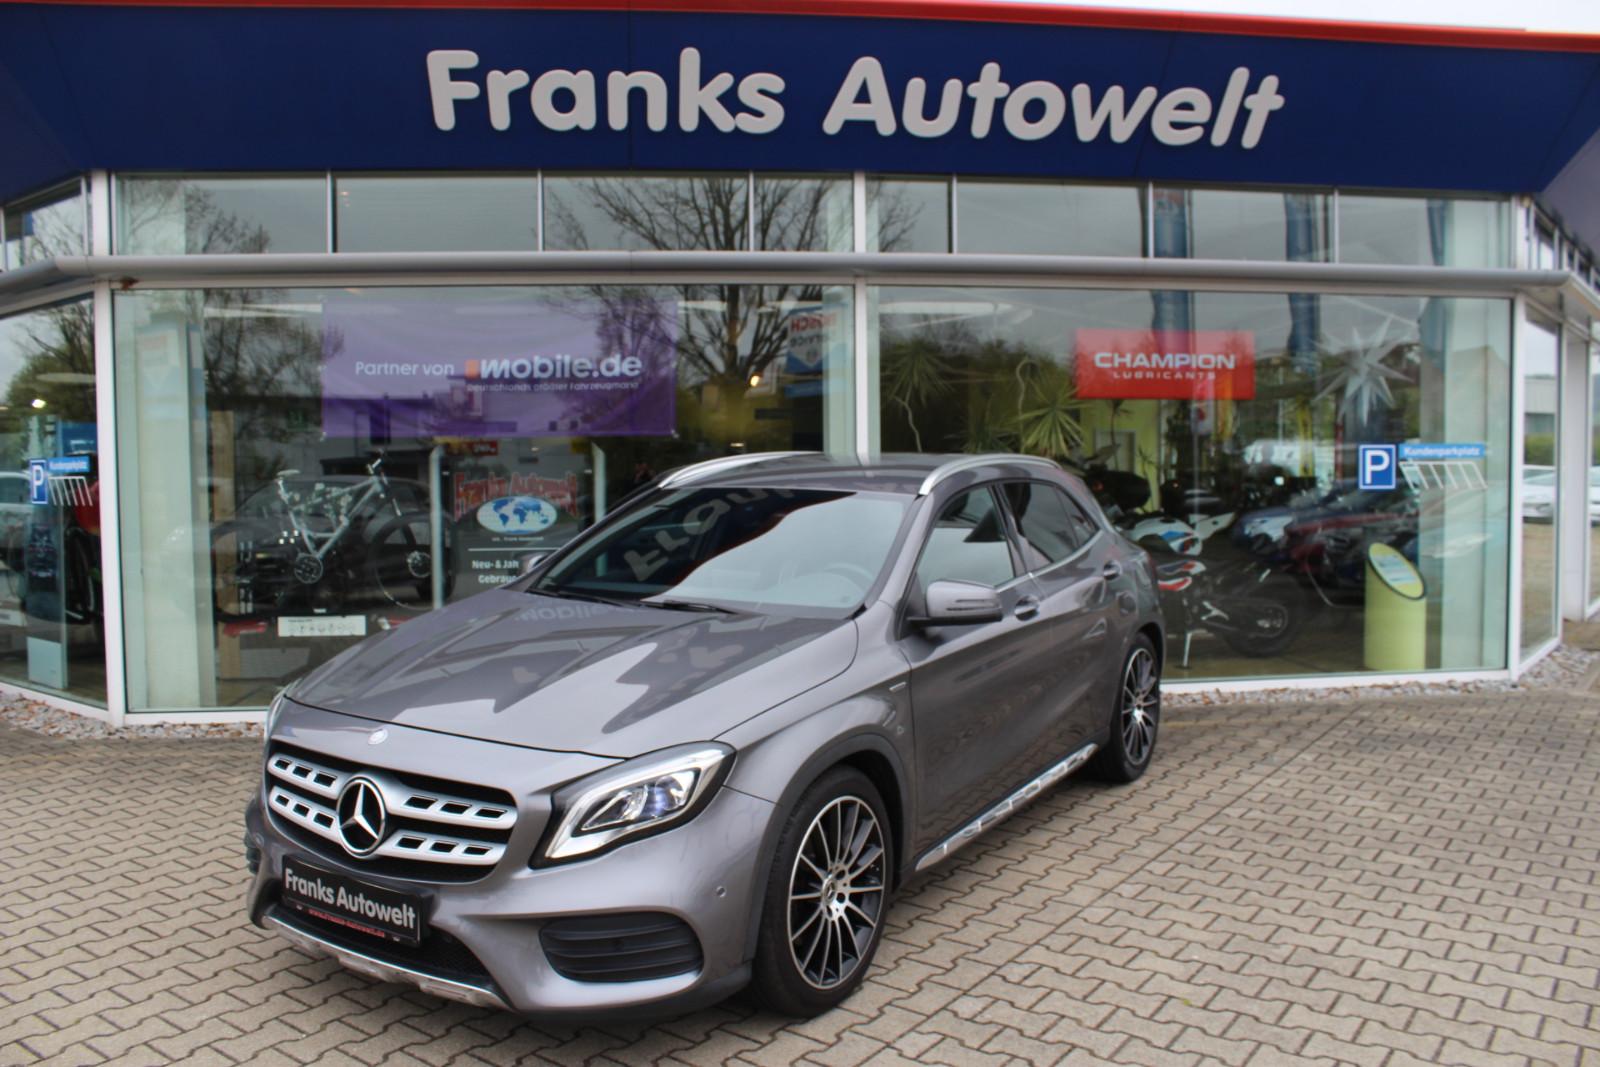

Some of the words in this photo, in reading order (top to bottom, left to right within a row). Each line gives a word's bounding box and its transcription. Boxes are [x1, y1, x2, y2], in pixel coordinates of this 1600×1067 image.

[426, 48, 785, 133] Franks
[822, 56, 1285, 150] Autowelt
[355, 361, 417, 376] Partner
[422, 364, 455, 375] von
[480, 353, 642, 379] mobile.de
[1093, 352, 1236, 369] CHAMPION
[1113, 371, 1216, 380] LUBRICANTS
[32, 464, 44, 499] P
[1365, 450, 1389, 484] P
[285, 868, 334, 905] Franks
[336, 886, 416, 929] Autowelt
